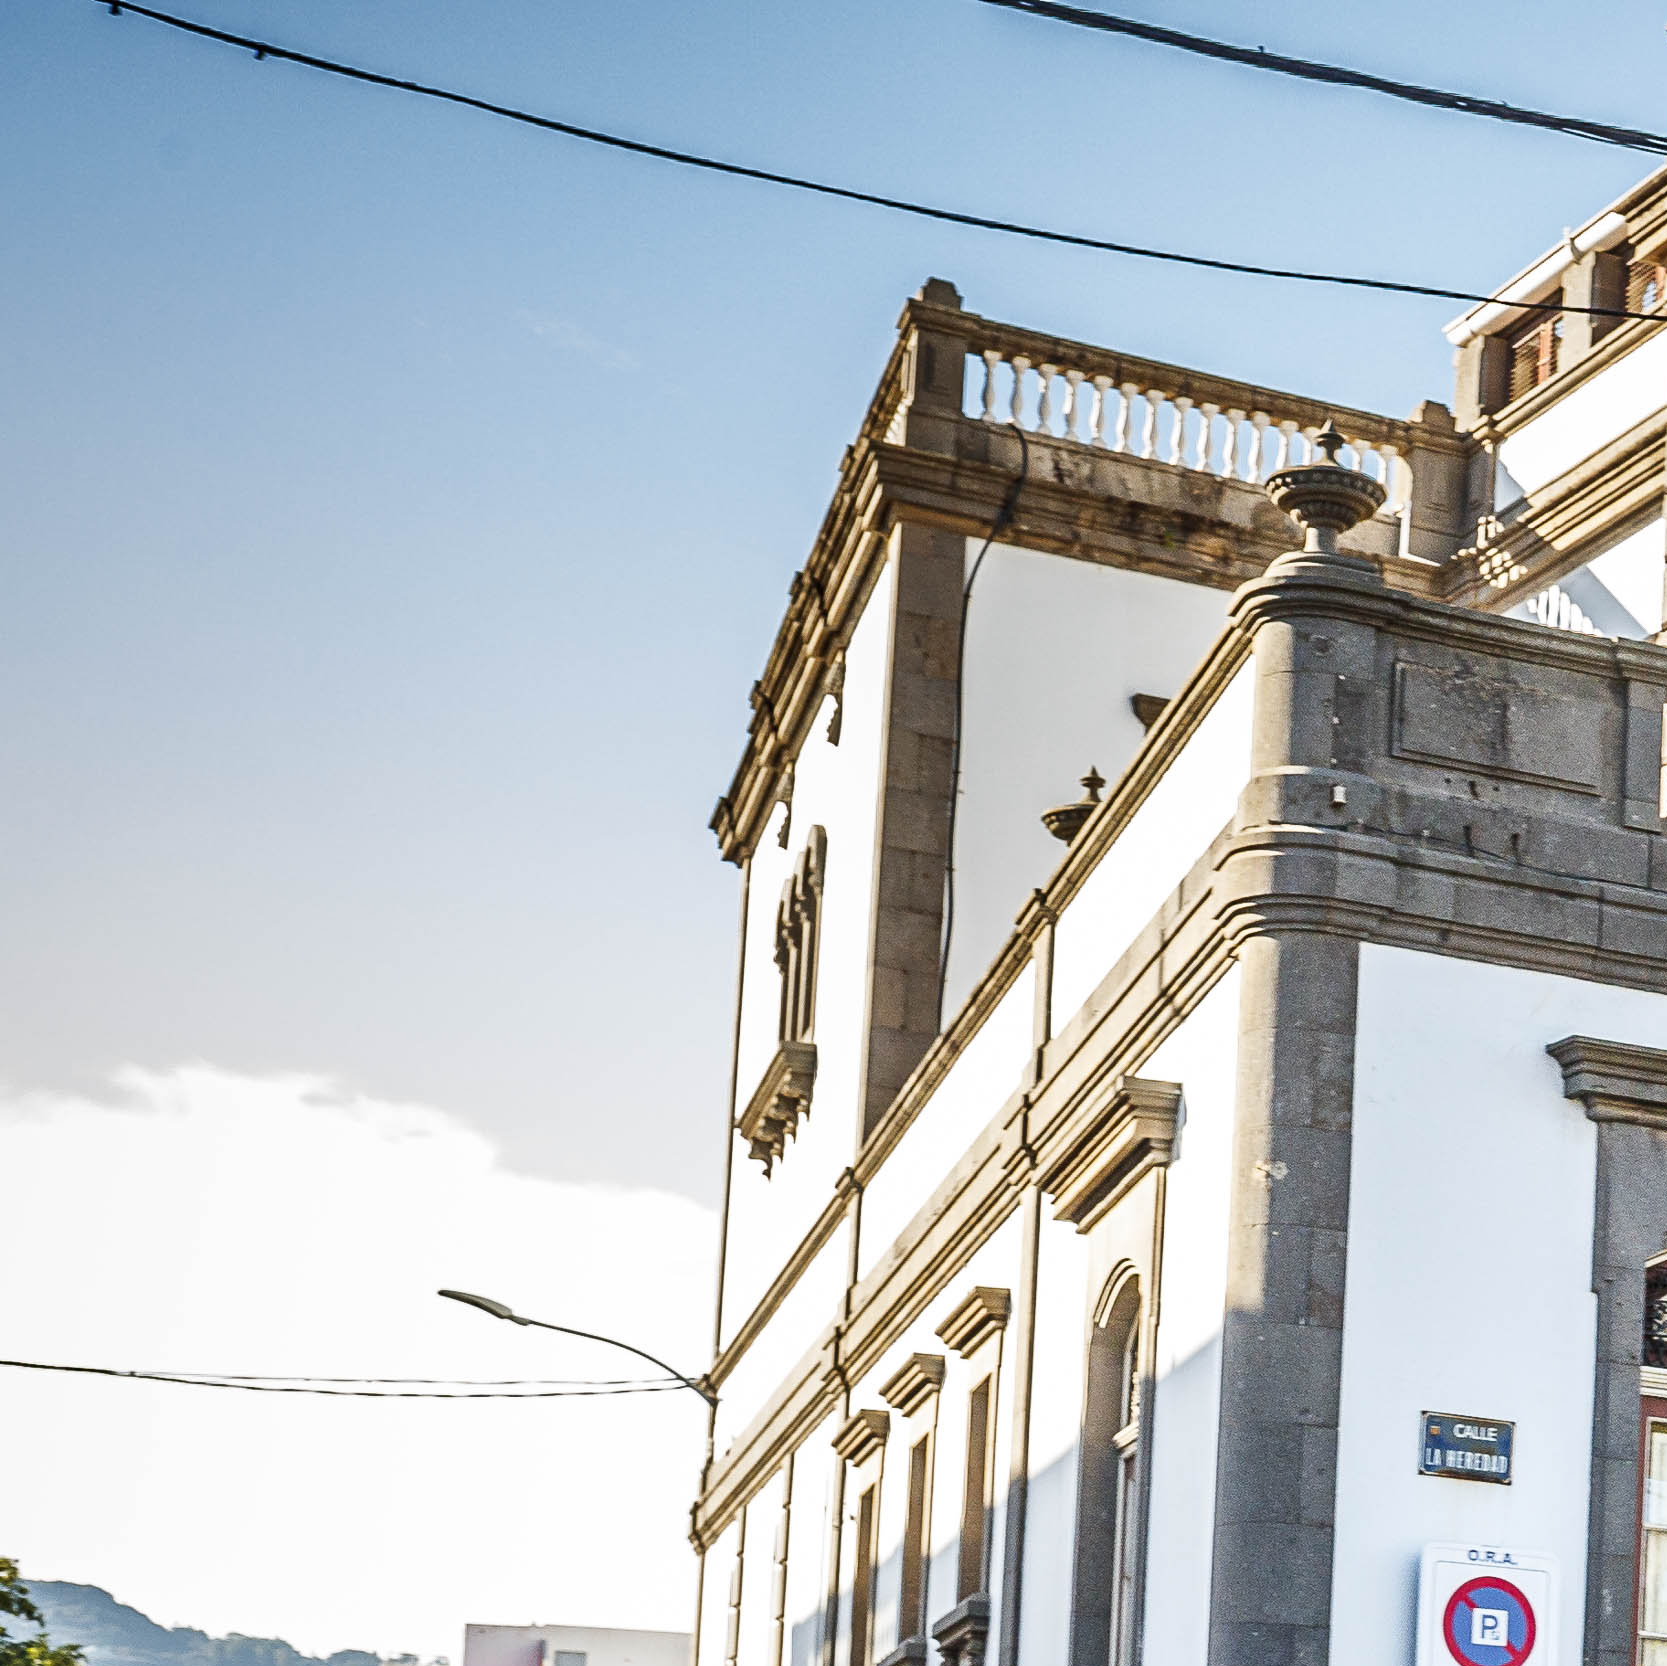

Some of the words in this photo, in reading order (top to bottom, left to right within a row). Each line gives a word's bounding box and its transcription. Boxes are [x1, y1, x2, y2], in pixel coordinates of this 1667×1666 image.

[1452, 1423, 1498, 1442] CALLE
[1425, 1447, 1442, 1466] LA
[1445, 1449, 1509, 1474] HEREDAD
